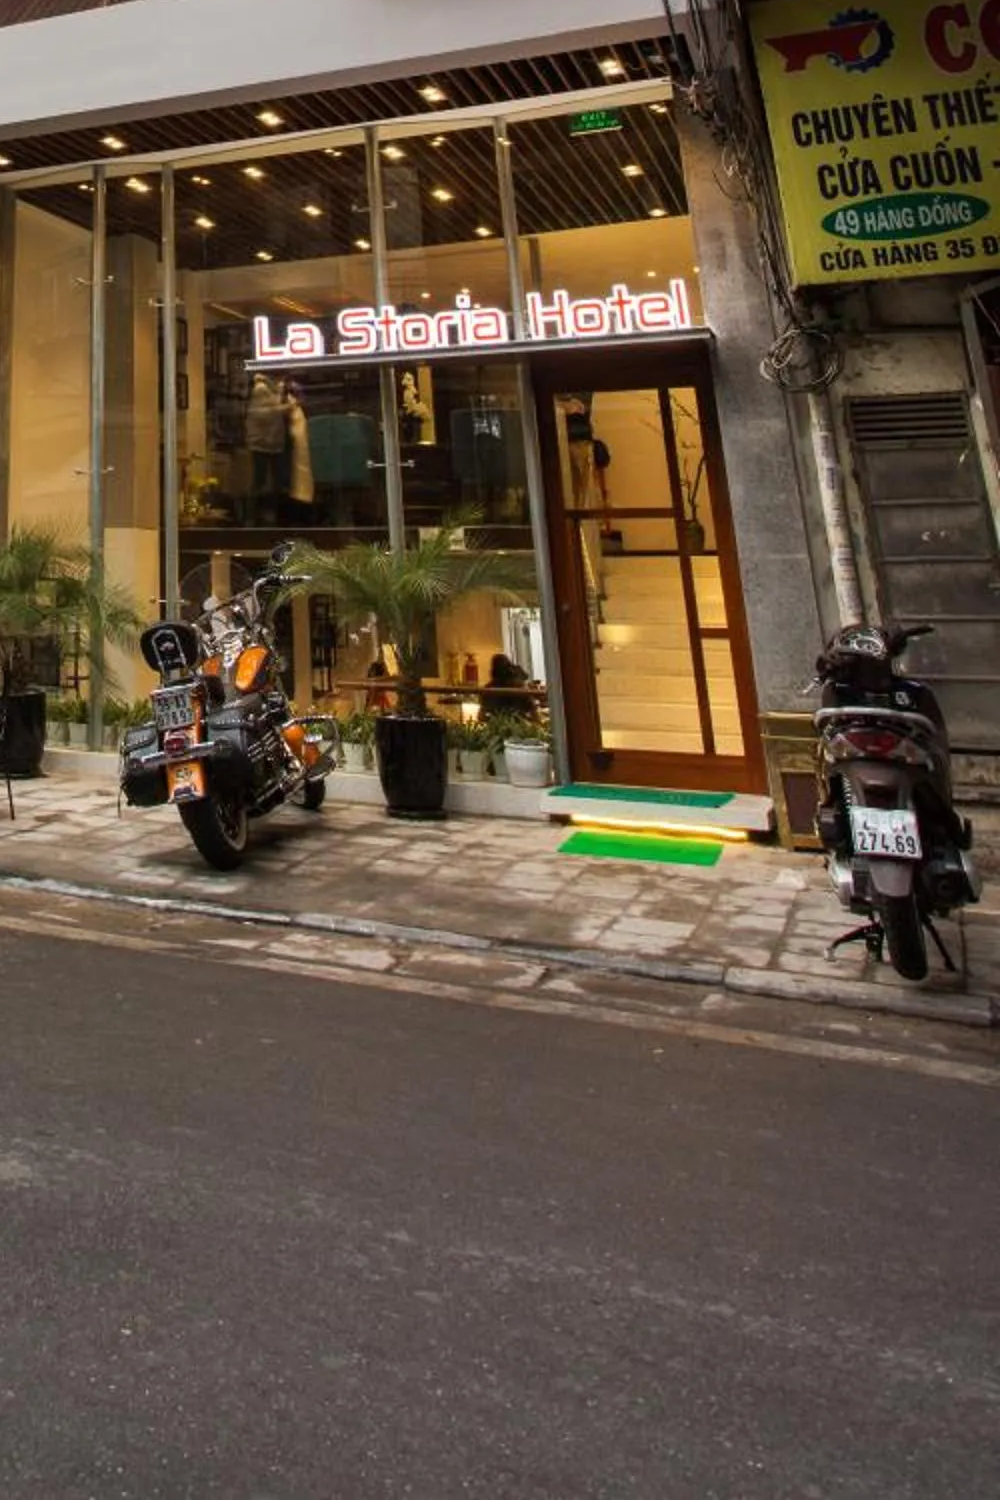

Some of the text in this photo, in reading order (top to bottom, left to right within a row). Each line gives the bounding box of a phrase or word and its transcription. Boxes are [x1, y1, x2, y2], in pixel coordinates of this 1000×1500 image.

[792, 72, 1000, 147] CHUYÊN THIẾ
[817, 135, 983, 200] CỬA CUỐN
[833, 209, 860, 235] 49
[863, 204, 916, 233] HÀNG
[820, 241, 867, 271] CỬA
[872, 240, 938, 267] HÀNG
[944, 237, 976, 260] 35
[254, 276, 692, 362] La Storia Hotel
